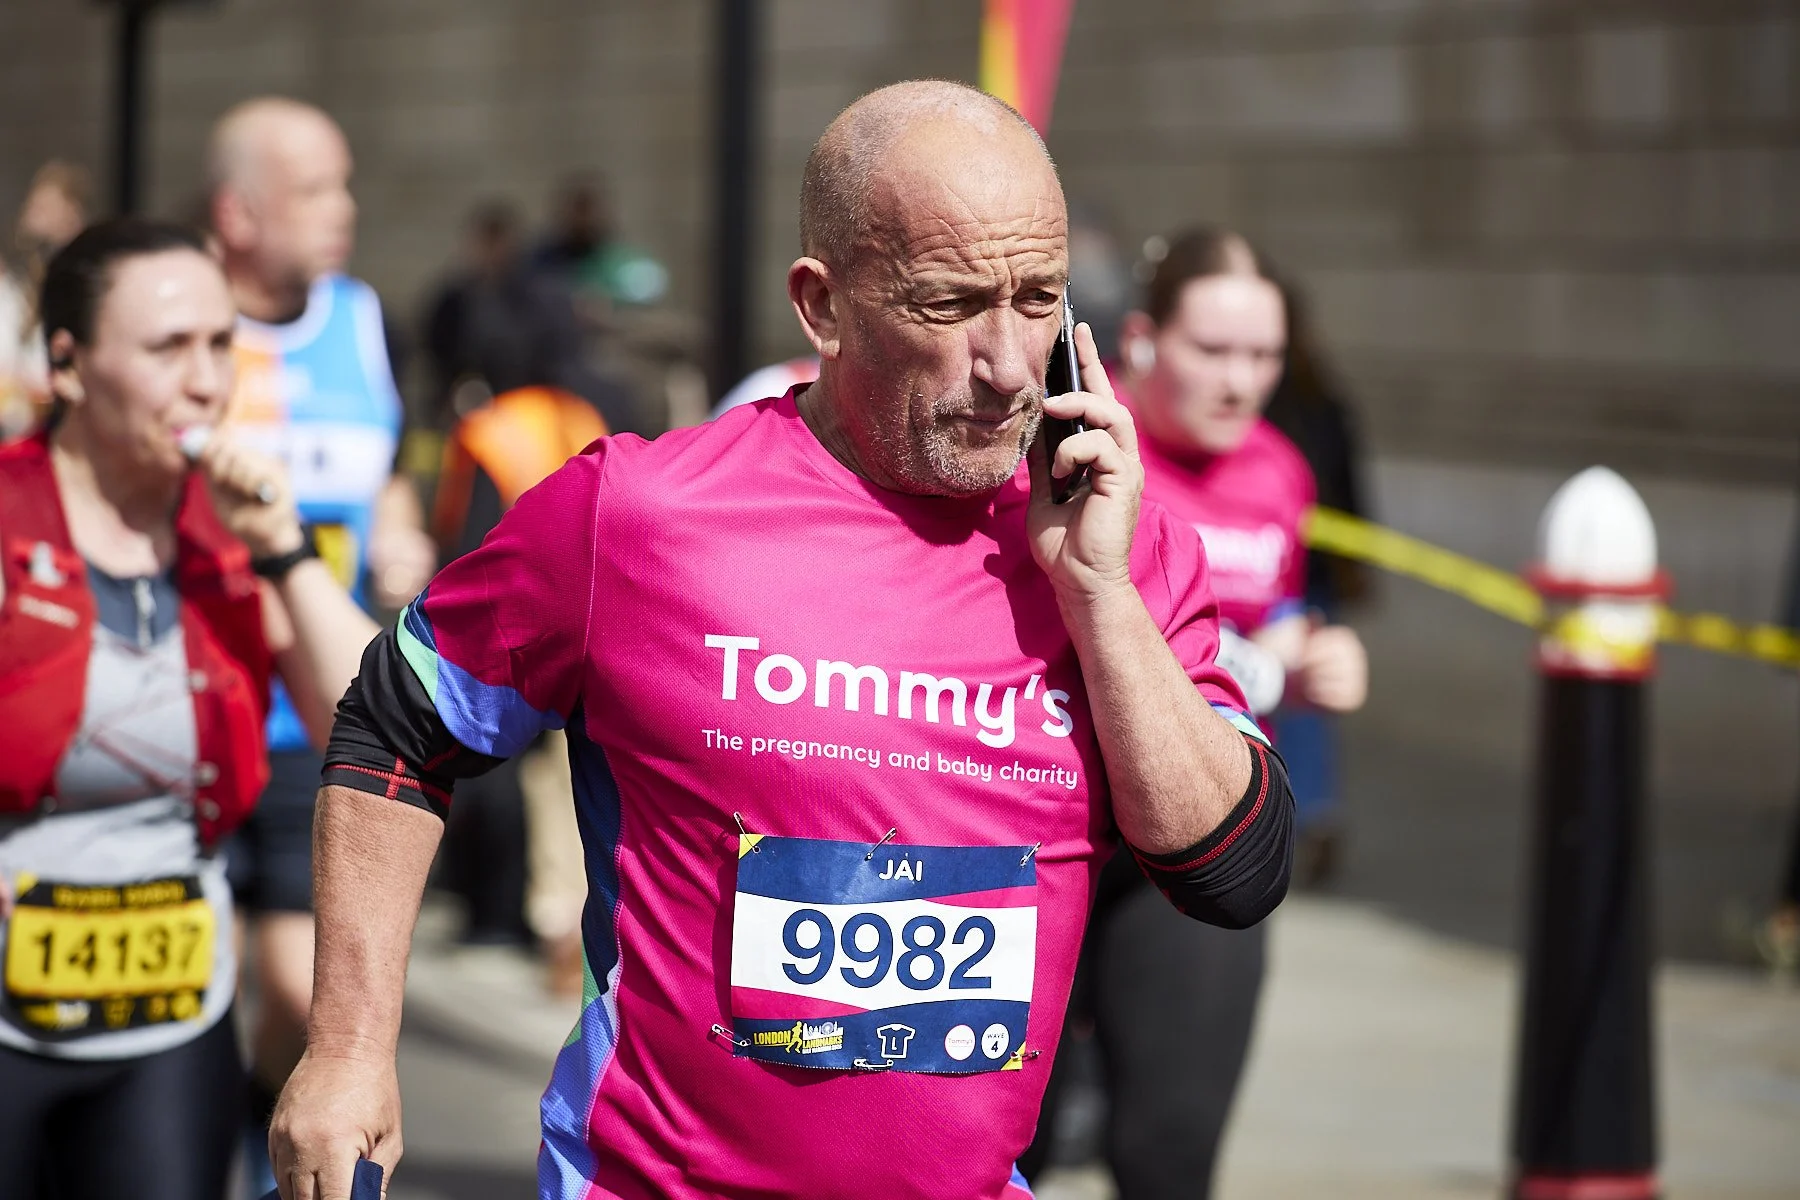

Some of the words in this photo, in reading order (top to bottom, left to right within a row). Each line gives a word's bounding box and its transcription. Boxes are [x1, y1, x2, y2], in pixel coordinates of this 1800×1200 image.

[704, 634, 1074, 749] Tommy's
[701, 729, 743, 751] The
[751, 735, 881, 768] pregnancy
[888, 750, 931, 772] and
[937, 752, 993, 782] baby
[999, 760, 1079, 790] charity
[878, 859, 924, 882] JAI
[33, 921, 203, 977] 14137
[782, 908, 996, 991] 9982
[753, 1030, 792, 1045] LONDON
[802, 1035, 843, 1049] LANDMARKS
[990, 1041, 999, 1053] 4
